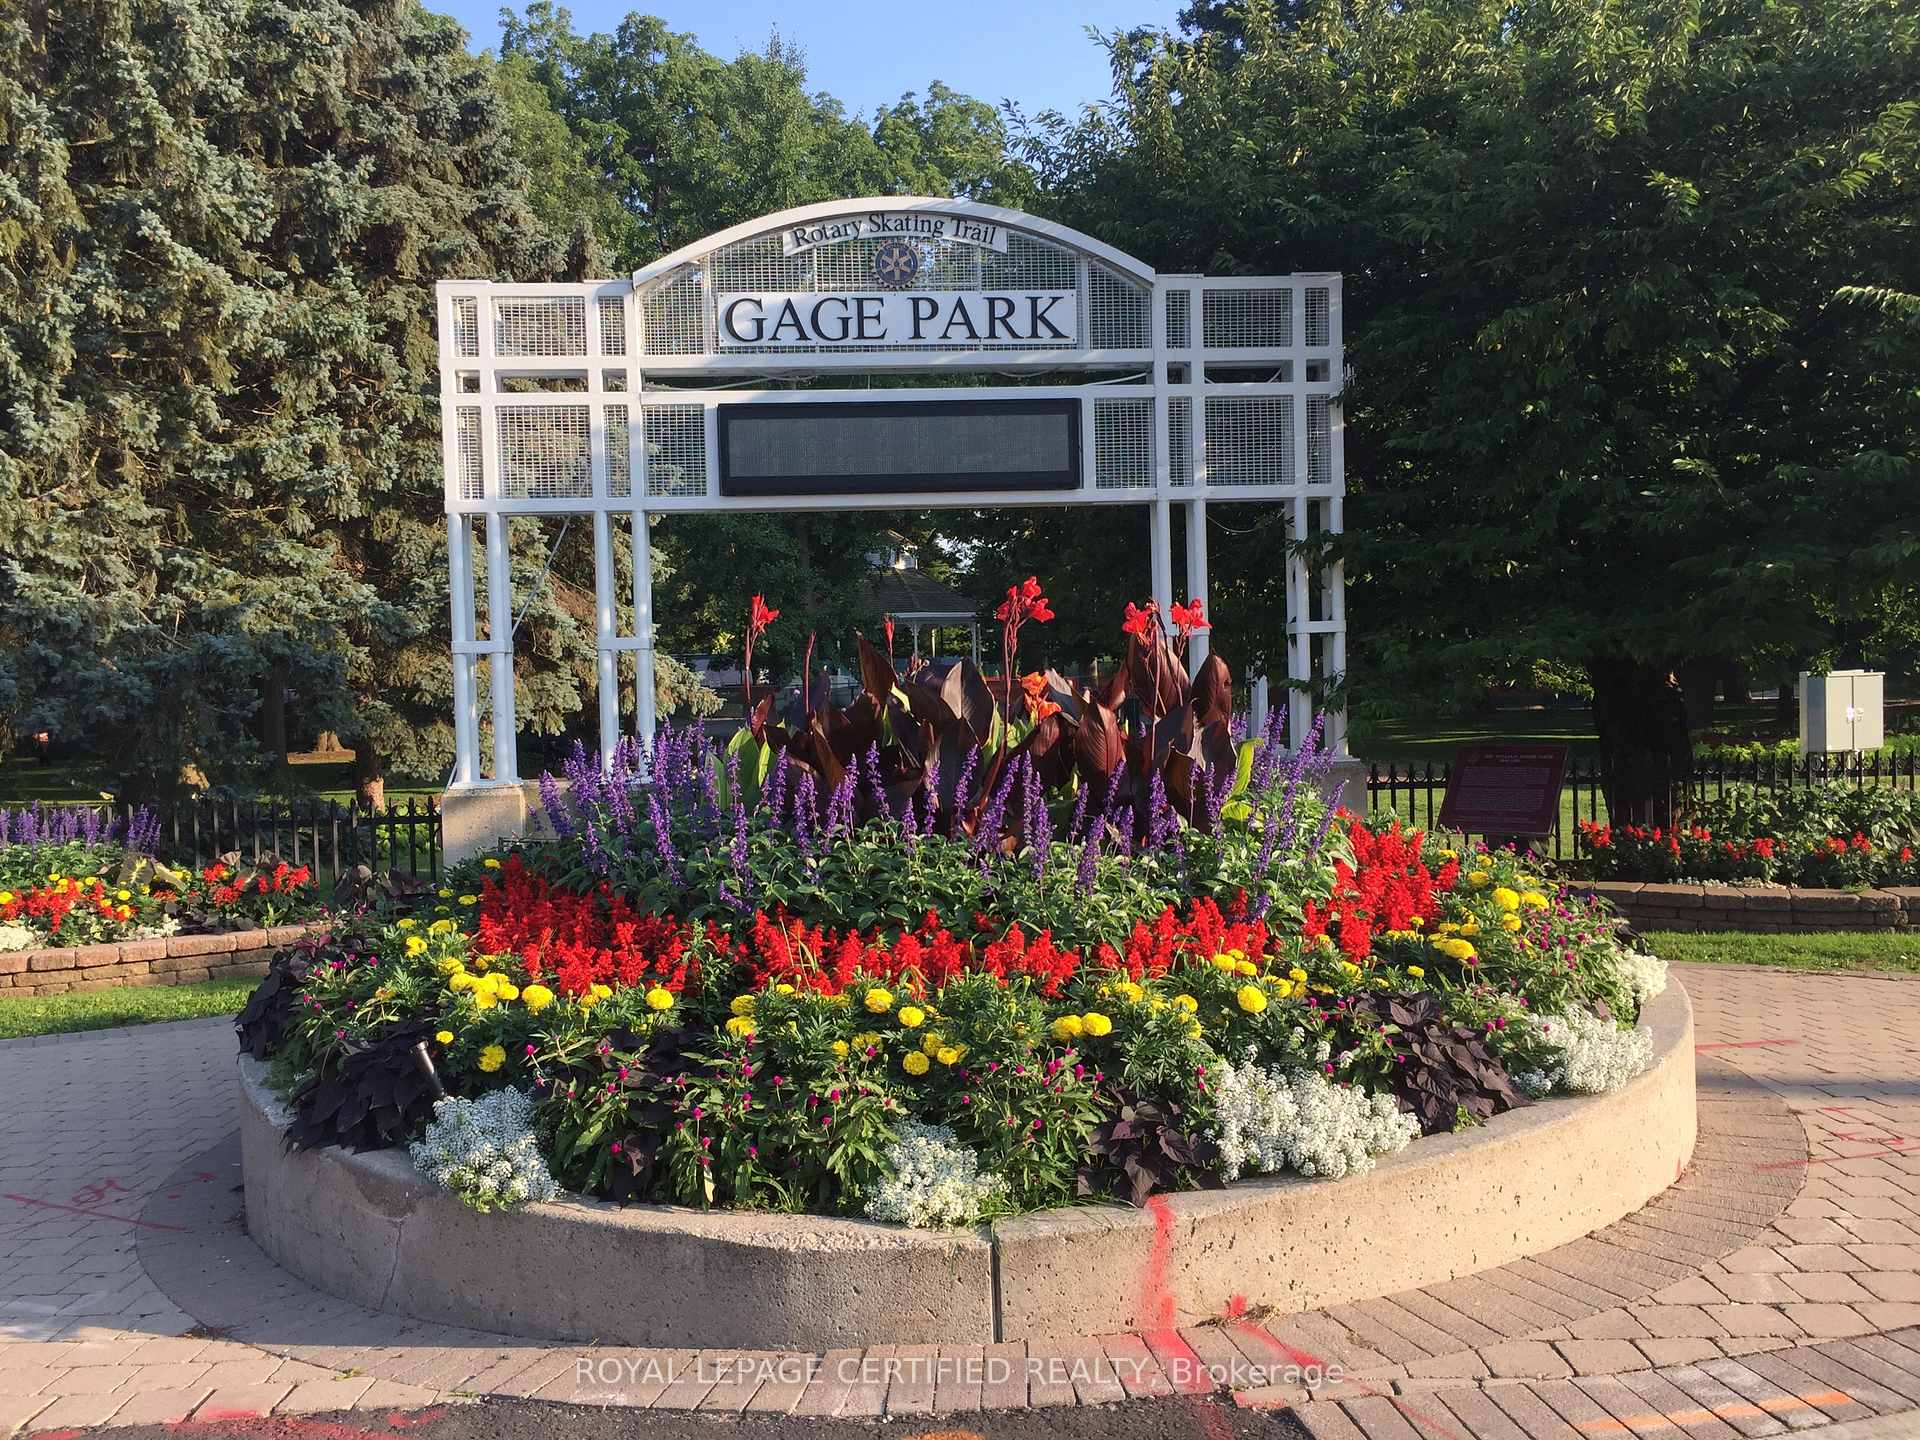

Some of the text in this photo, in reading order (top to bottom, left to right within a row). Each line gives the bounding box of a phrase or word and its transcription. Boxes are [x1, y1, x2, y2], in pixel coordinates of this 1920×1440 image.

[792, 213, 997, 248] Rotary Skating Trail
[724, 296, 1069, 342] GAGE PARK
